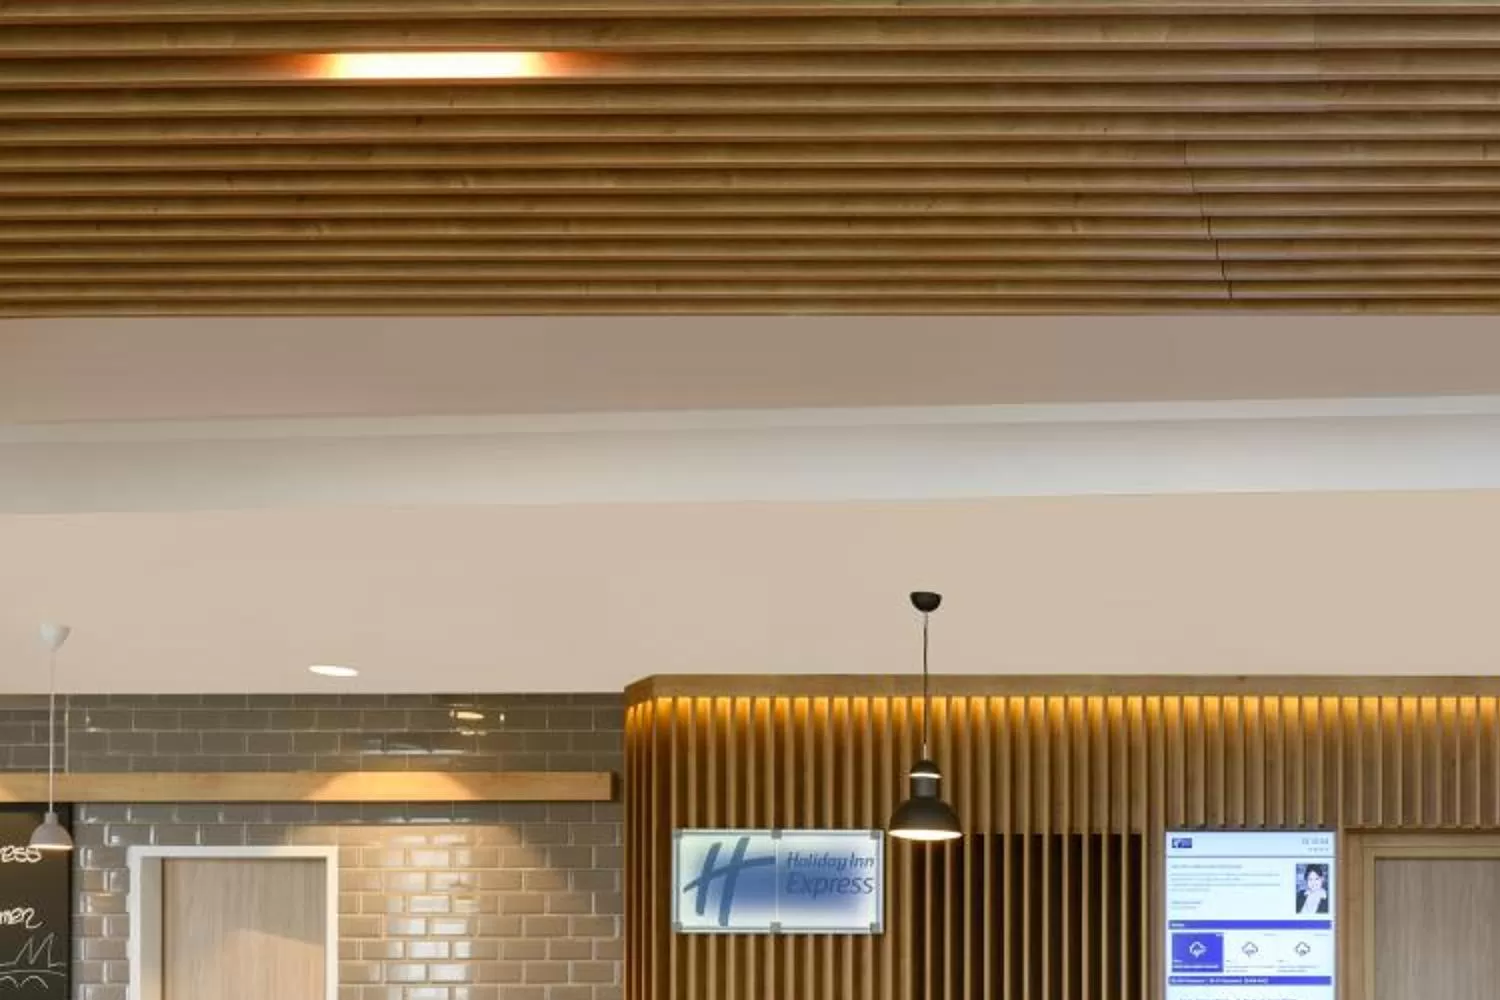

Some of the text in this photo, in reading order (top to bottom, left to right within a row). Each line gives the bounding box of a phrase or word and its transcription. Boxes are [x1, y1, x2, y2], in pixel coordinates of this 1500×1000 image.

[0, 845, 42, 863] ess
[787, 851, 875, 871] Holiday Inn
[786, 871, 874, 900] Express
